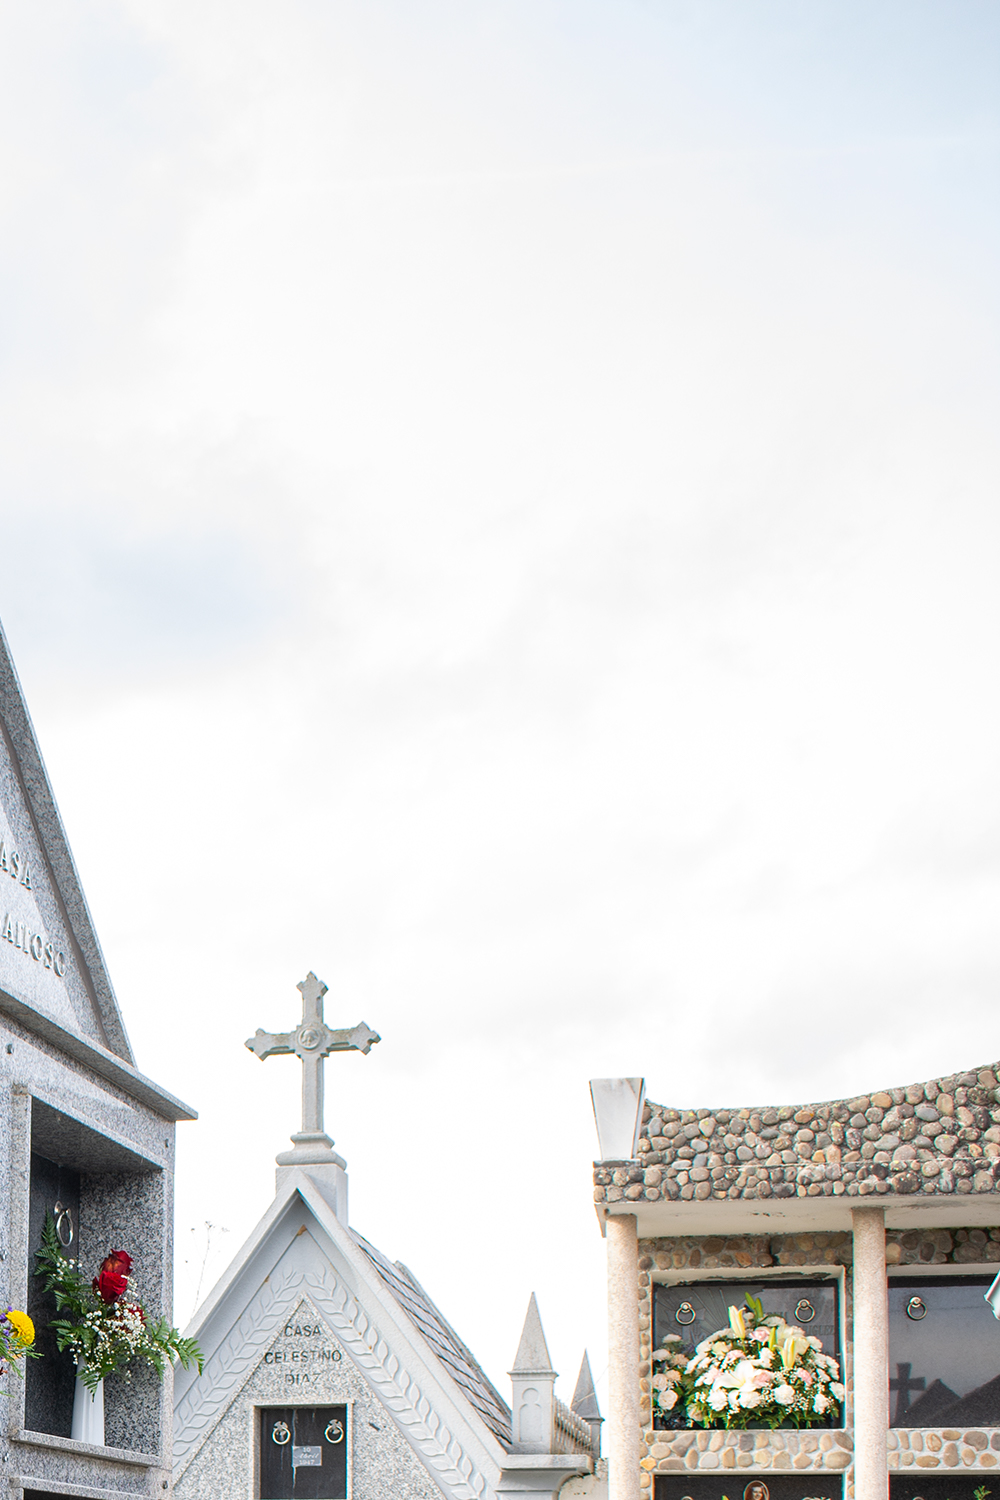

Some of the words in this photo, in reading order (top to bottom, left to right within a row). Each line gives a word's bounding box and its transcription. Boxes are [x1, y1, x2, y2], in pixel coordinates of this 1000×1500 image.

[284, 1325, 321, 1337] CASA
[264, 1350, 342, 1364] CELESTINO
[285, 1373, 321, 1385] DIAZ
